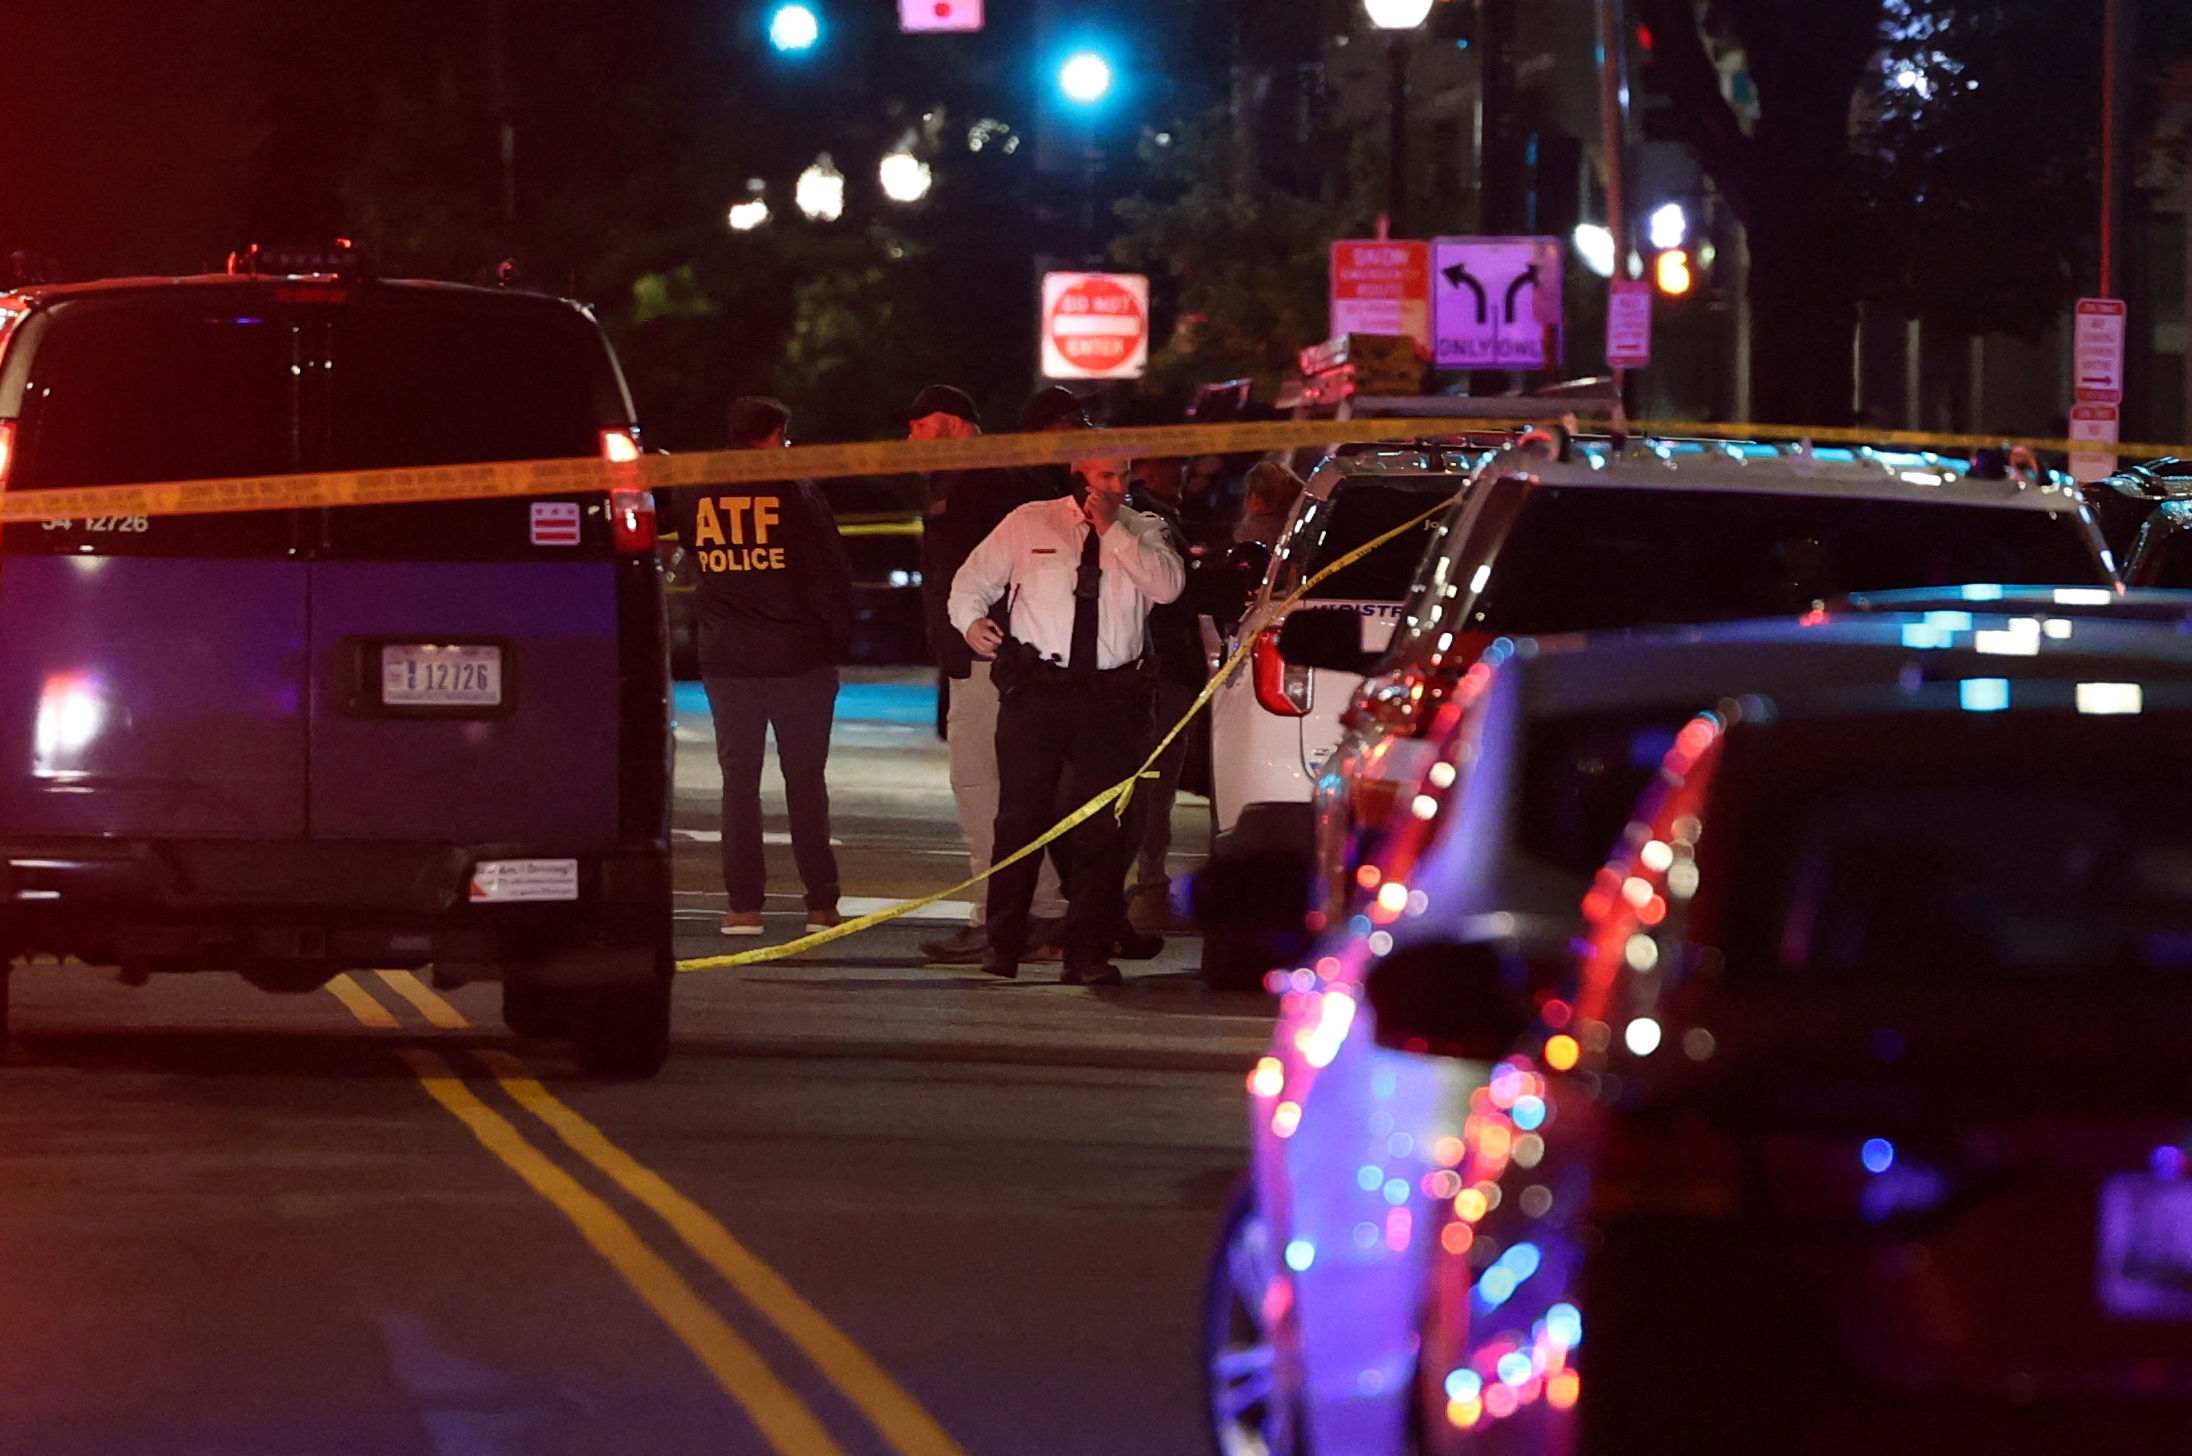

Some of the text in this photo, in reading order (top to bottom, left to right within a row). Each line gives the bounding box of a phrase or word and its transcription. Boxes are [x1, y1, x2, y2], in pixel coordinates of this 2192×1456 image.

[1065, 338, 1124, 356] ENTER
[1440, 339, 1492, 357] ONLY
[695, 496, 779, 546] ATF
[698, 547, 786, 572] POLICE
